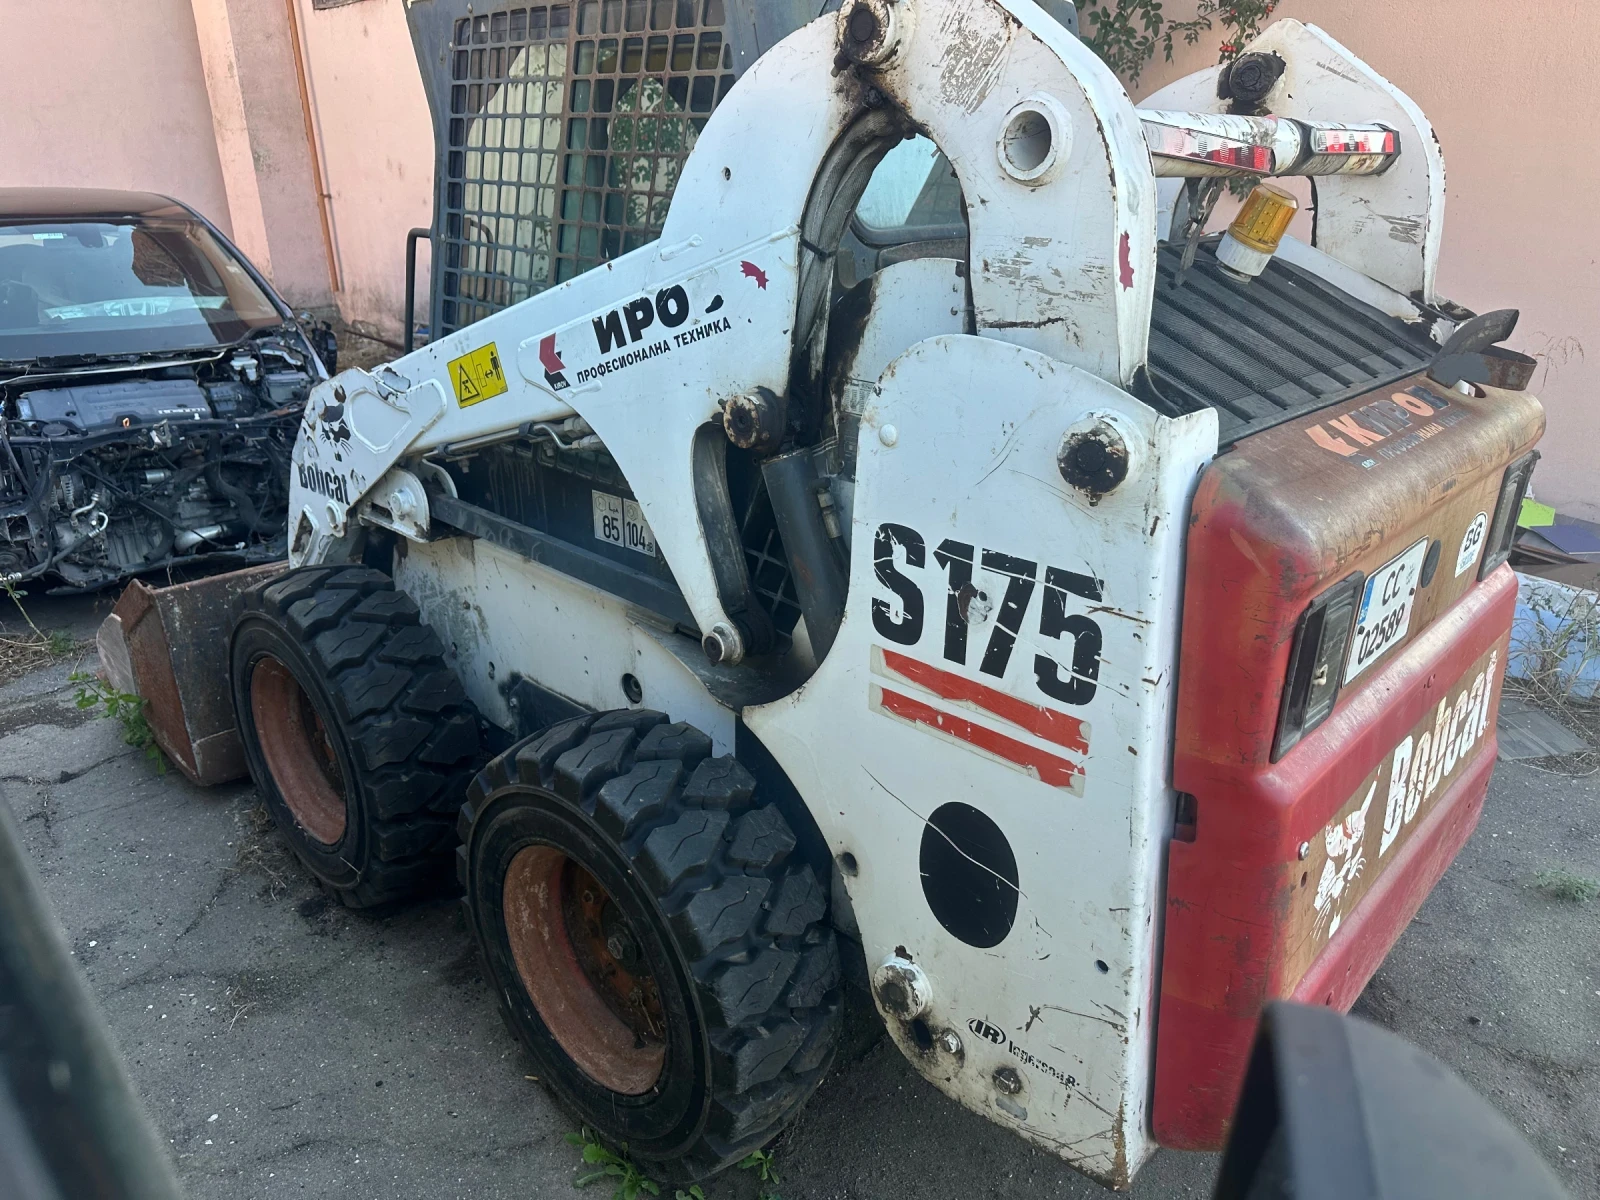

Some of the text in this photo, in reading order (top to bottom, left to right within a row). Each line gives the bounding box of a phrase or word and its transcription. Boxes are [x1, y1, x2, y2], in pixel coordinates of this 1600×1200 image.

[576, 316, 732, 384] ПРОФЕСИОНАЛНА ТЕХНИКА
[592, 284, 724, 355] ИРО
[298, 462, 351, 506] Bobcat
[602, 514, 620, 542] 85
[626, 521, 646, 551] 104
[871, 522, 1105, 706] S175
[1357, 601, 1406, 666] 02589
[1378, 650, 1497, 859] Bobcat
